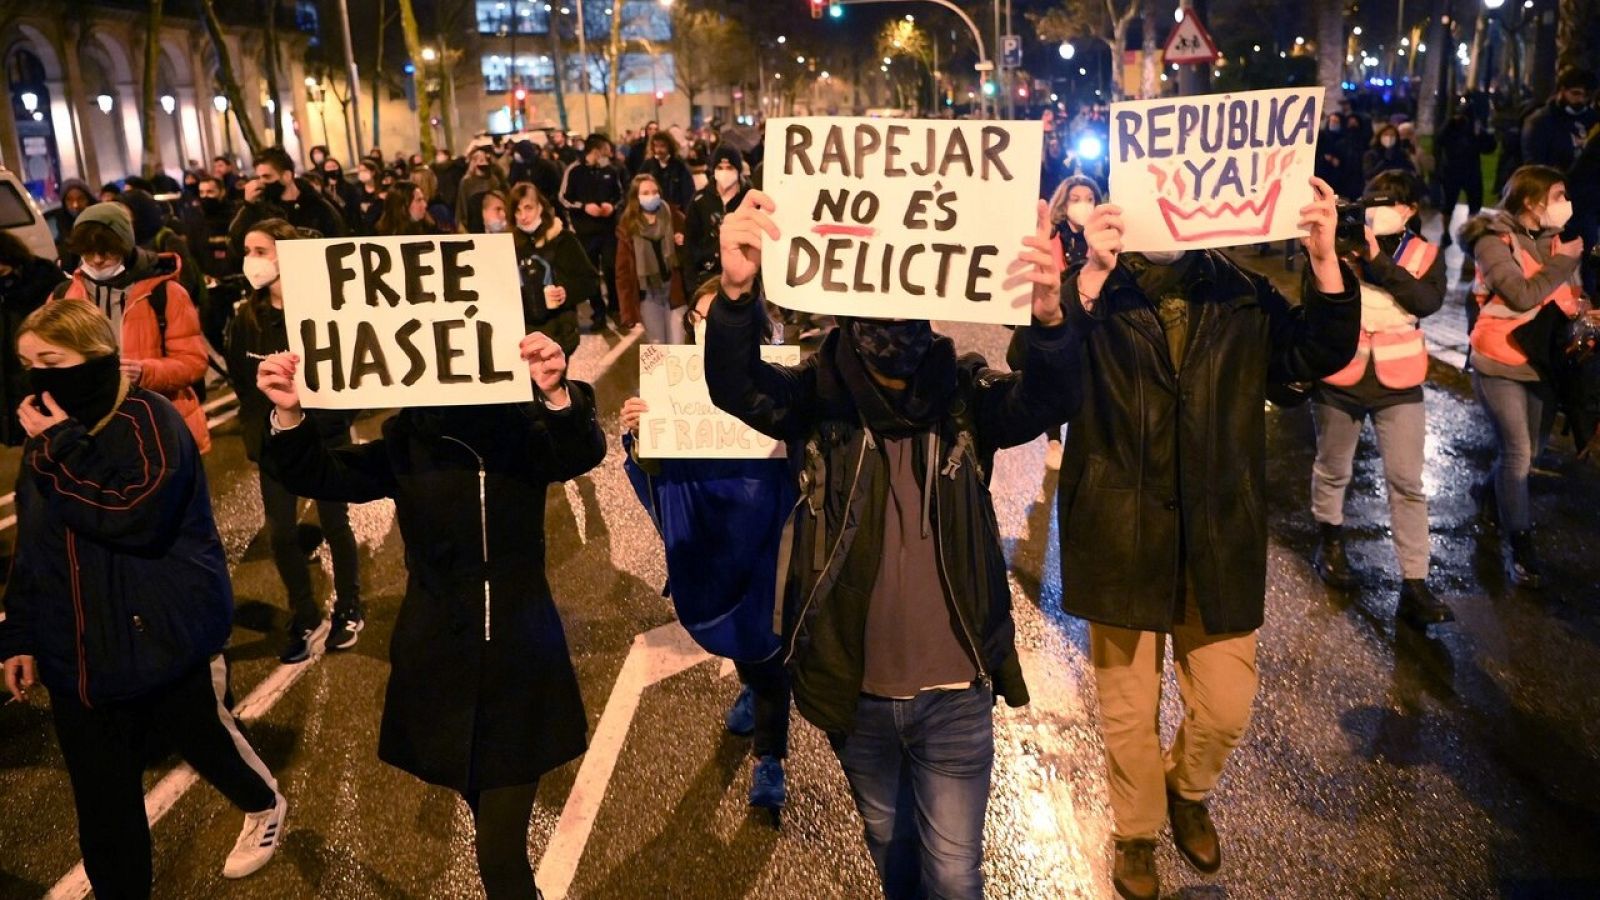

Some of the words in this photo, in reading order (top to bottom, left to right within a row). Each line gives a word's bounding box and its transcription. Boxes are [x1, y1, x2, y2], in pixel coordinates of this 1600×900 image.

[1005, 40, 1017, 55] P
[784, 124, 1013, 180] RAPEJAR
[1184, 152, 1258, 201] YA!
[812, 189, 879, 224] NO
[325, 240, 479, 310] FREE
[786, 236, 999, 301] DELICTE
[300, 305, 514, 392] HASÉL
